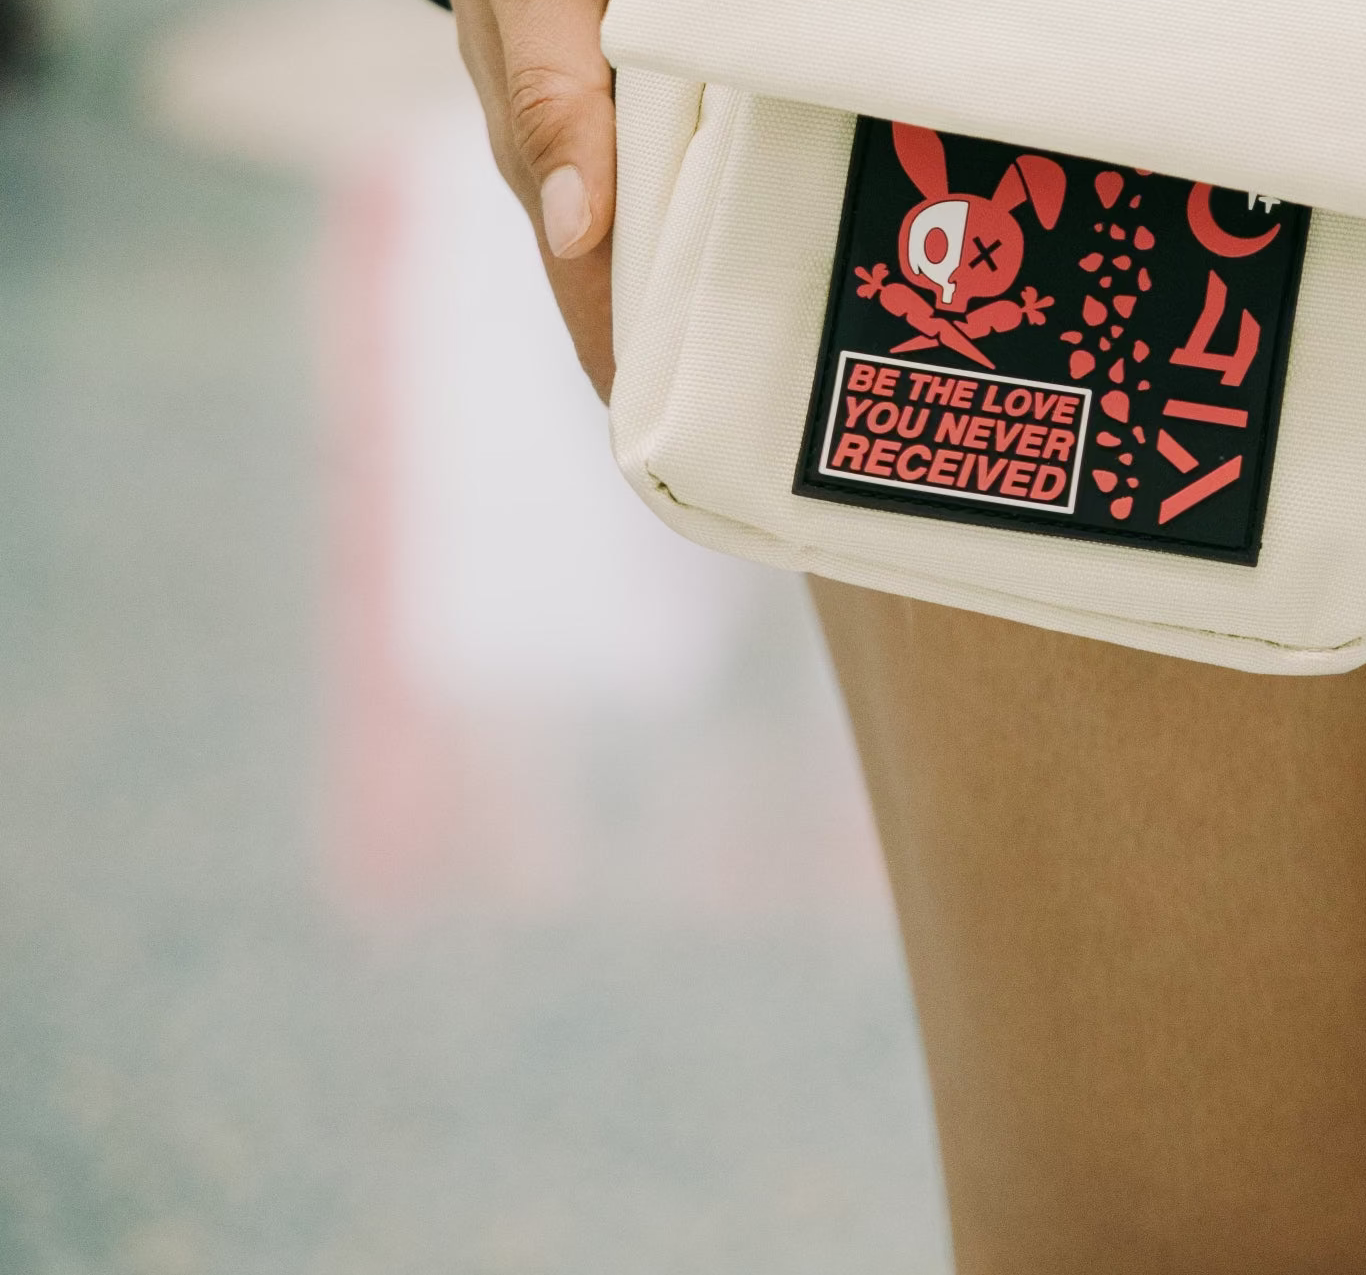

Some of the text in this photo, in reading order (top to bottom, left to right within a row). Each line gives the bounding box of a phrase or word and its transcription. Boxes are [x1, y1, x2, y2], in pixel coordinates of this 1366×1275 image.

[847, 363, 1080, 425] BE THE LOVE
[845, 396, 1076, 462] YOU NEVER
[831, 432, 1067, 502] RECEIVED
